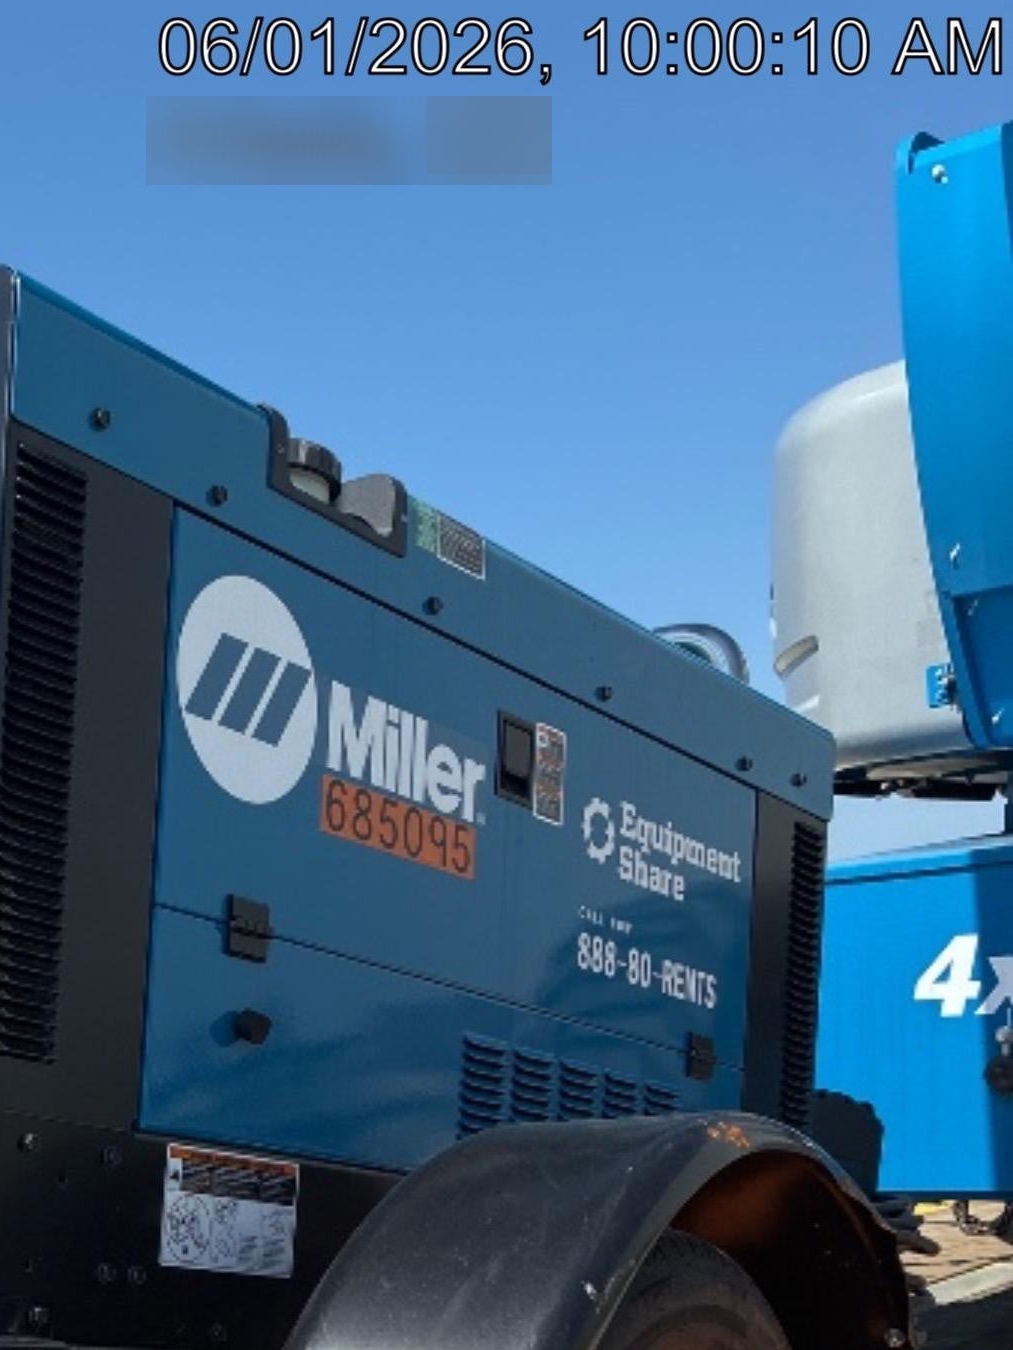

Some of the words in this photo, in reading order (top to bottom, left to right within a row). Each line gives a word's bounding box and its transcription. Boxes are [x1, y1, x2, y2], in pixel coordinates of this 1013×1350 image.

[327, 680, 486, 823] Miller
[325, 779, 470, 873] 685095
[619, 800, 741, 883] Equipment
[617, 846, 685, 901] Share
[578, 932, 718, 1009] 888-80-RENTS
